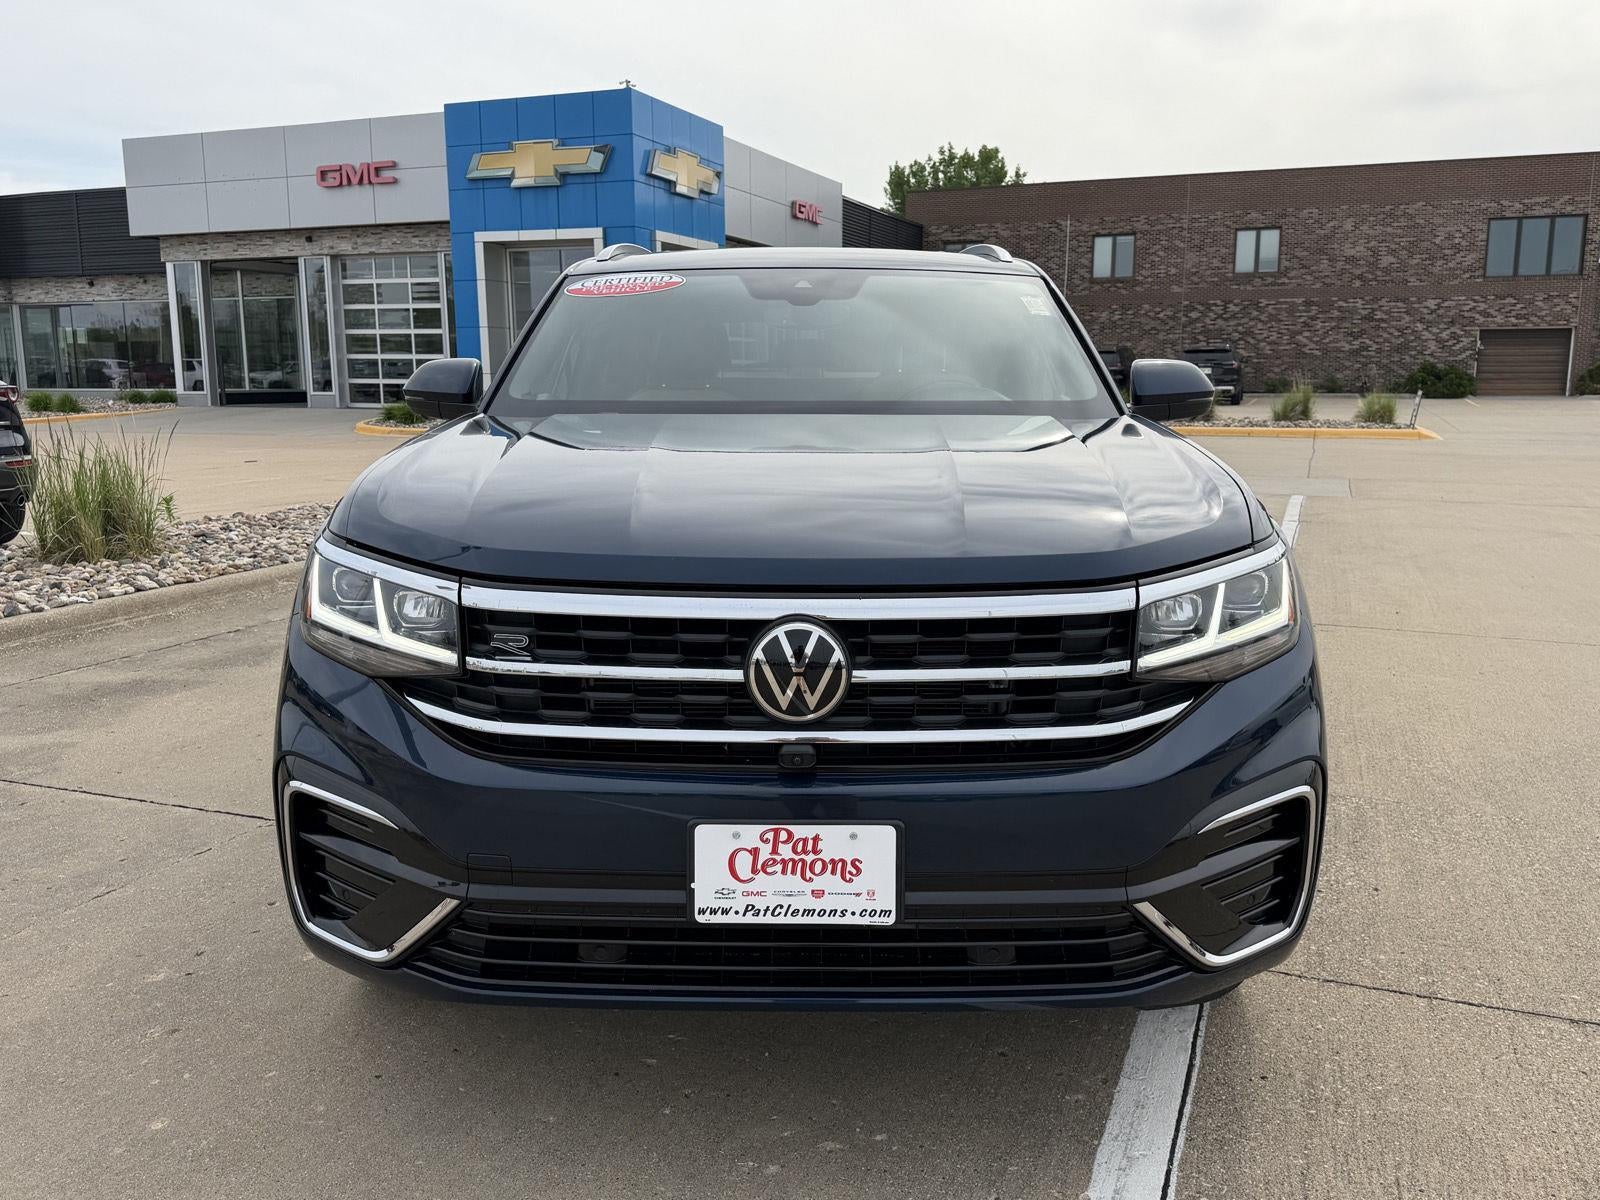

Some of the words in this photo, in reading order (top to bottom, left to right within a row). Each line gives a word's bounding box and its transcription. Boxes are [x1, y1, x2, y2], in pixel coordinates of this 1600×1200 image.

[316, 160, 398, 188] GMC
[791, 200, 824, 226] GMC
[580, 275, 673, 288] CERTIFIED
[592, 286, 651, 295] VEHICLE
[759, 827, 824, 856] Pat
[727, 846, 863, 884] Clemons
[697, 903, 892, 918] www.PatClemons.com
